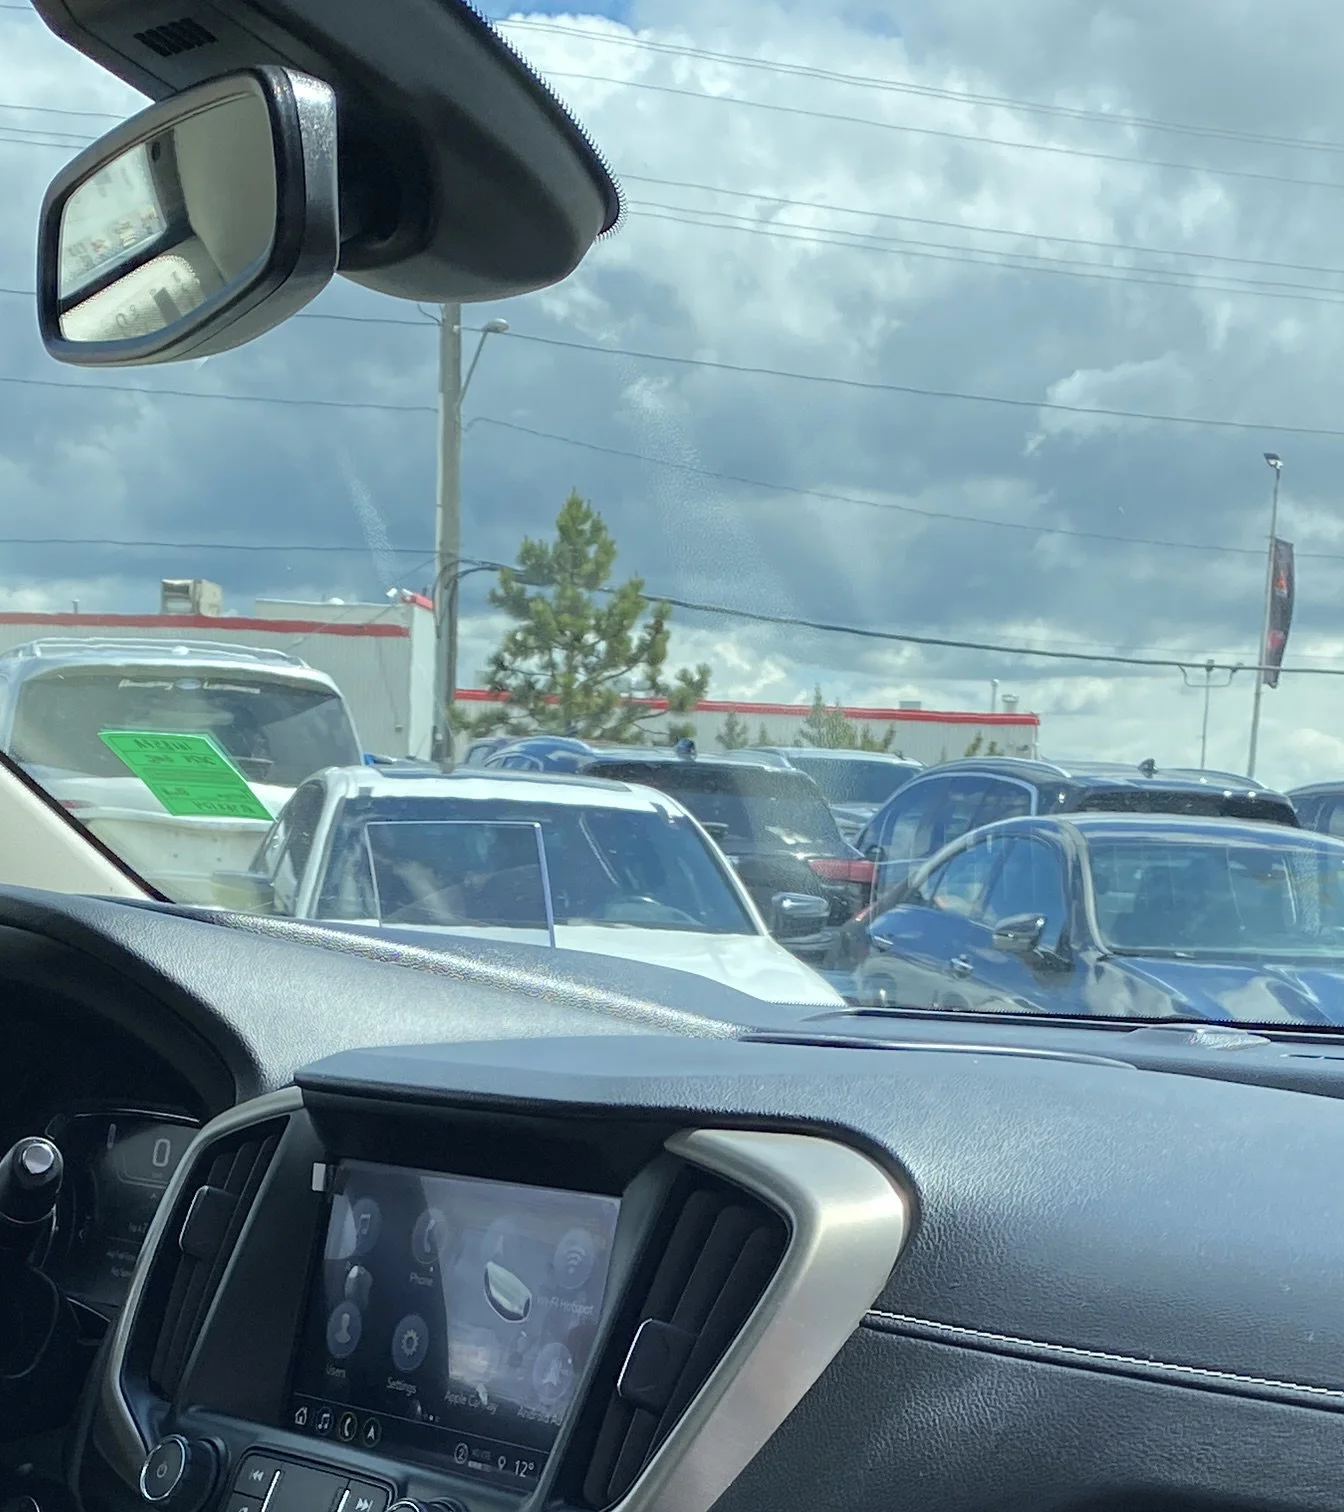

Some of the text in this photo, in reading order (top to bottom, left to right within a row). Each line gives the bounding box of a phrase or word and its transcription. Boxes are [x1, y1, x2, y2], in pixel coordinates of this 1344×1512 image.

[152, 1138, 171, 1168] 0
[325, 1364, 347, 1379] Users
[386, 1377, 418, 1397] Settings
[515, 1460, 535, 1478] 12°
